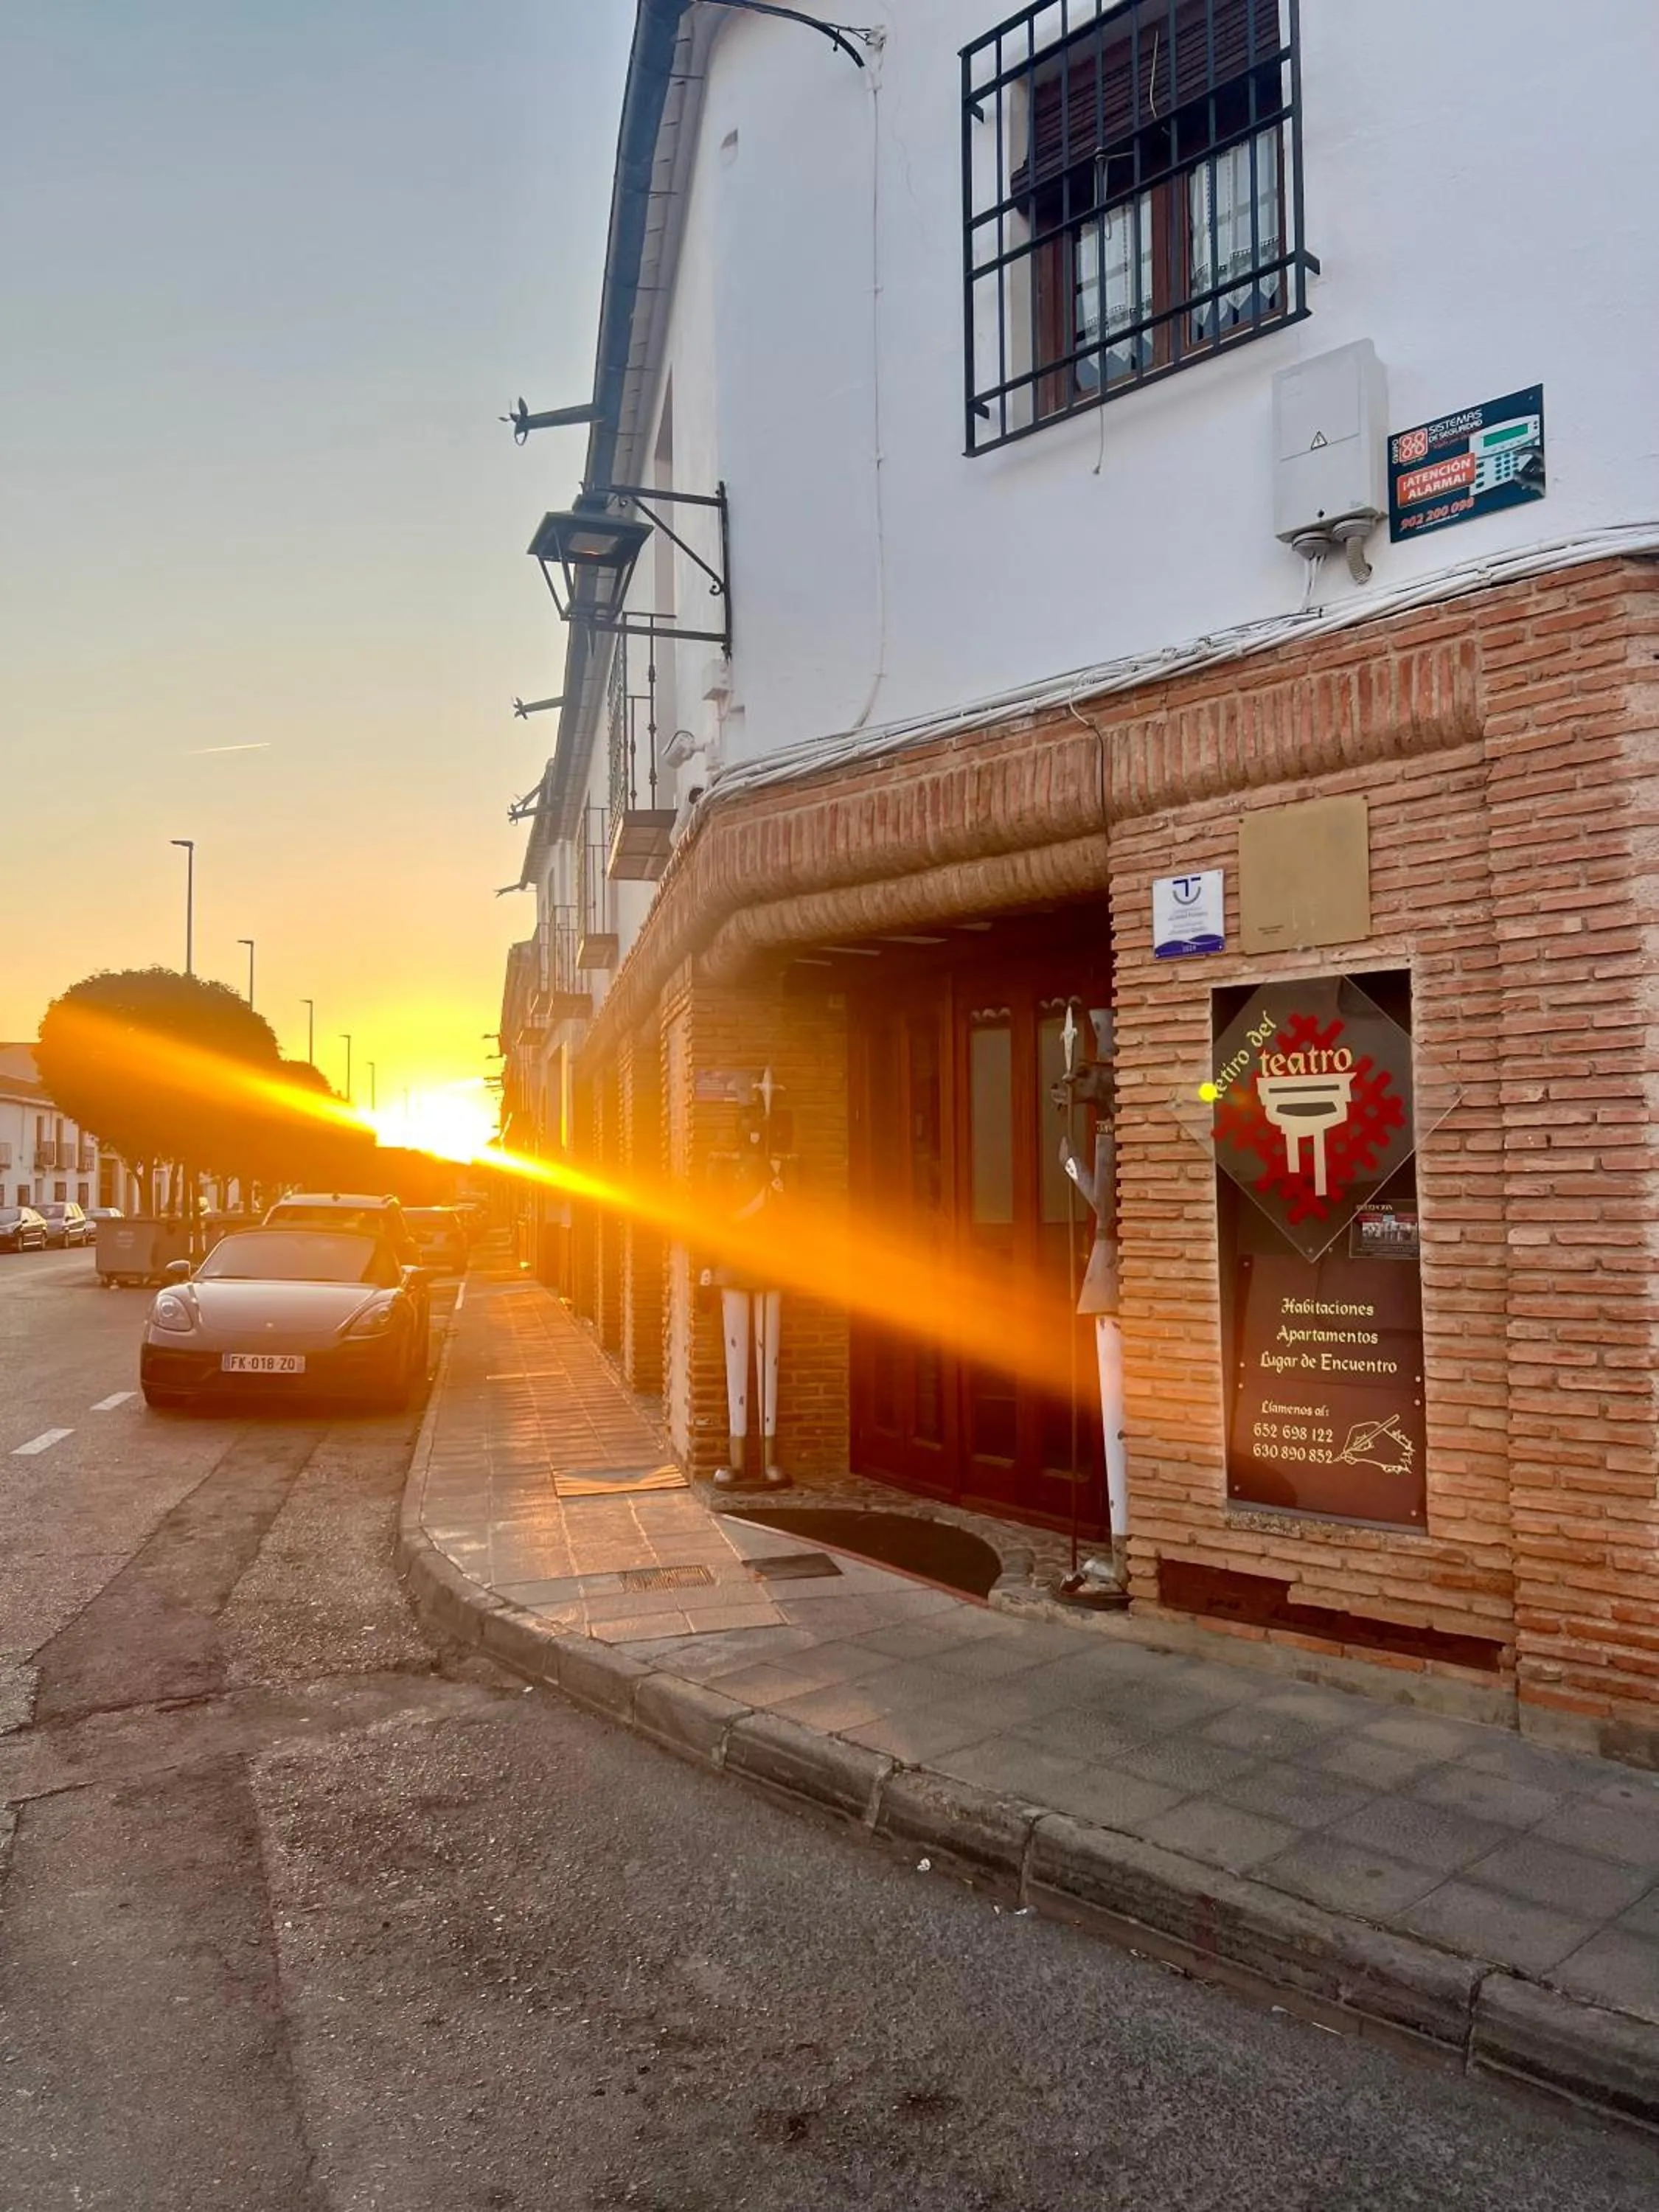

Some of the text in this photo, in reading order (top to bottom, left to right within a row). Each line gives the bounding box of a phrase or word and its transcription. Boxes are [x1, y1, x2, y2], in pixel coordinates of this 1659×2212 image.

[1428, 409, 1482, 436] SISTEMAS
[1402, 458, 1471, 491] ¡ATENCIÓN
[1407, 472, 1466, 500] ALARMA!
[1400, 512, 1424, 532] 902
[1425, 505, 1450, 523] 200
[1215, 1009, 1277, 1099] etiro del
[1259, 1044, 1353, 1078] teatro
[1281, 1297, 1375, 1317] Habitaciones
[1276, 1325, 1379, 1347] Apartamentos
[1260, 1350, 1397, 1374] Lugar de Encuentro
[1253, 1422, 1333, 1443] 652 698 122
[1253, 1443, 1333, 1464] 630 890 852
